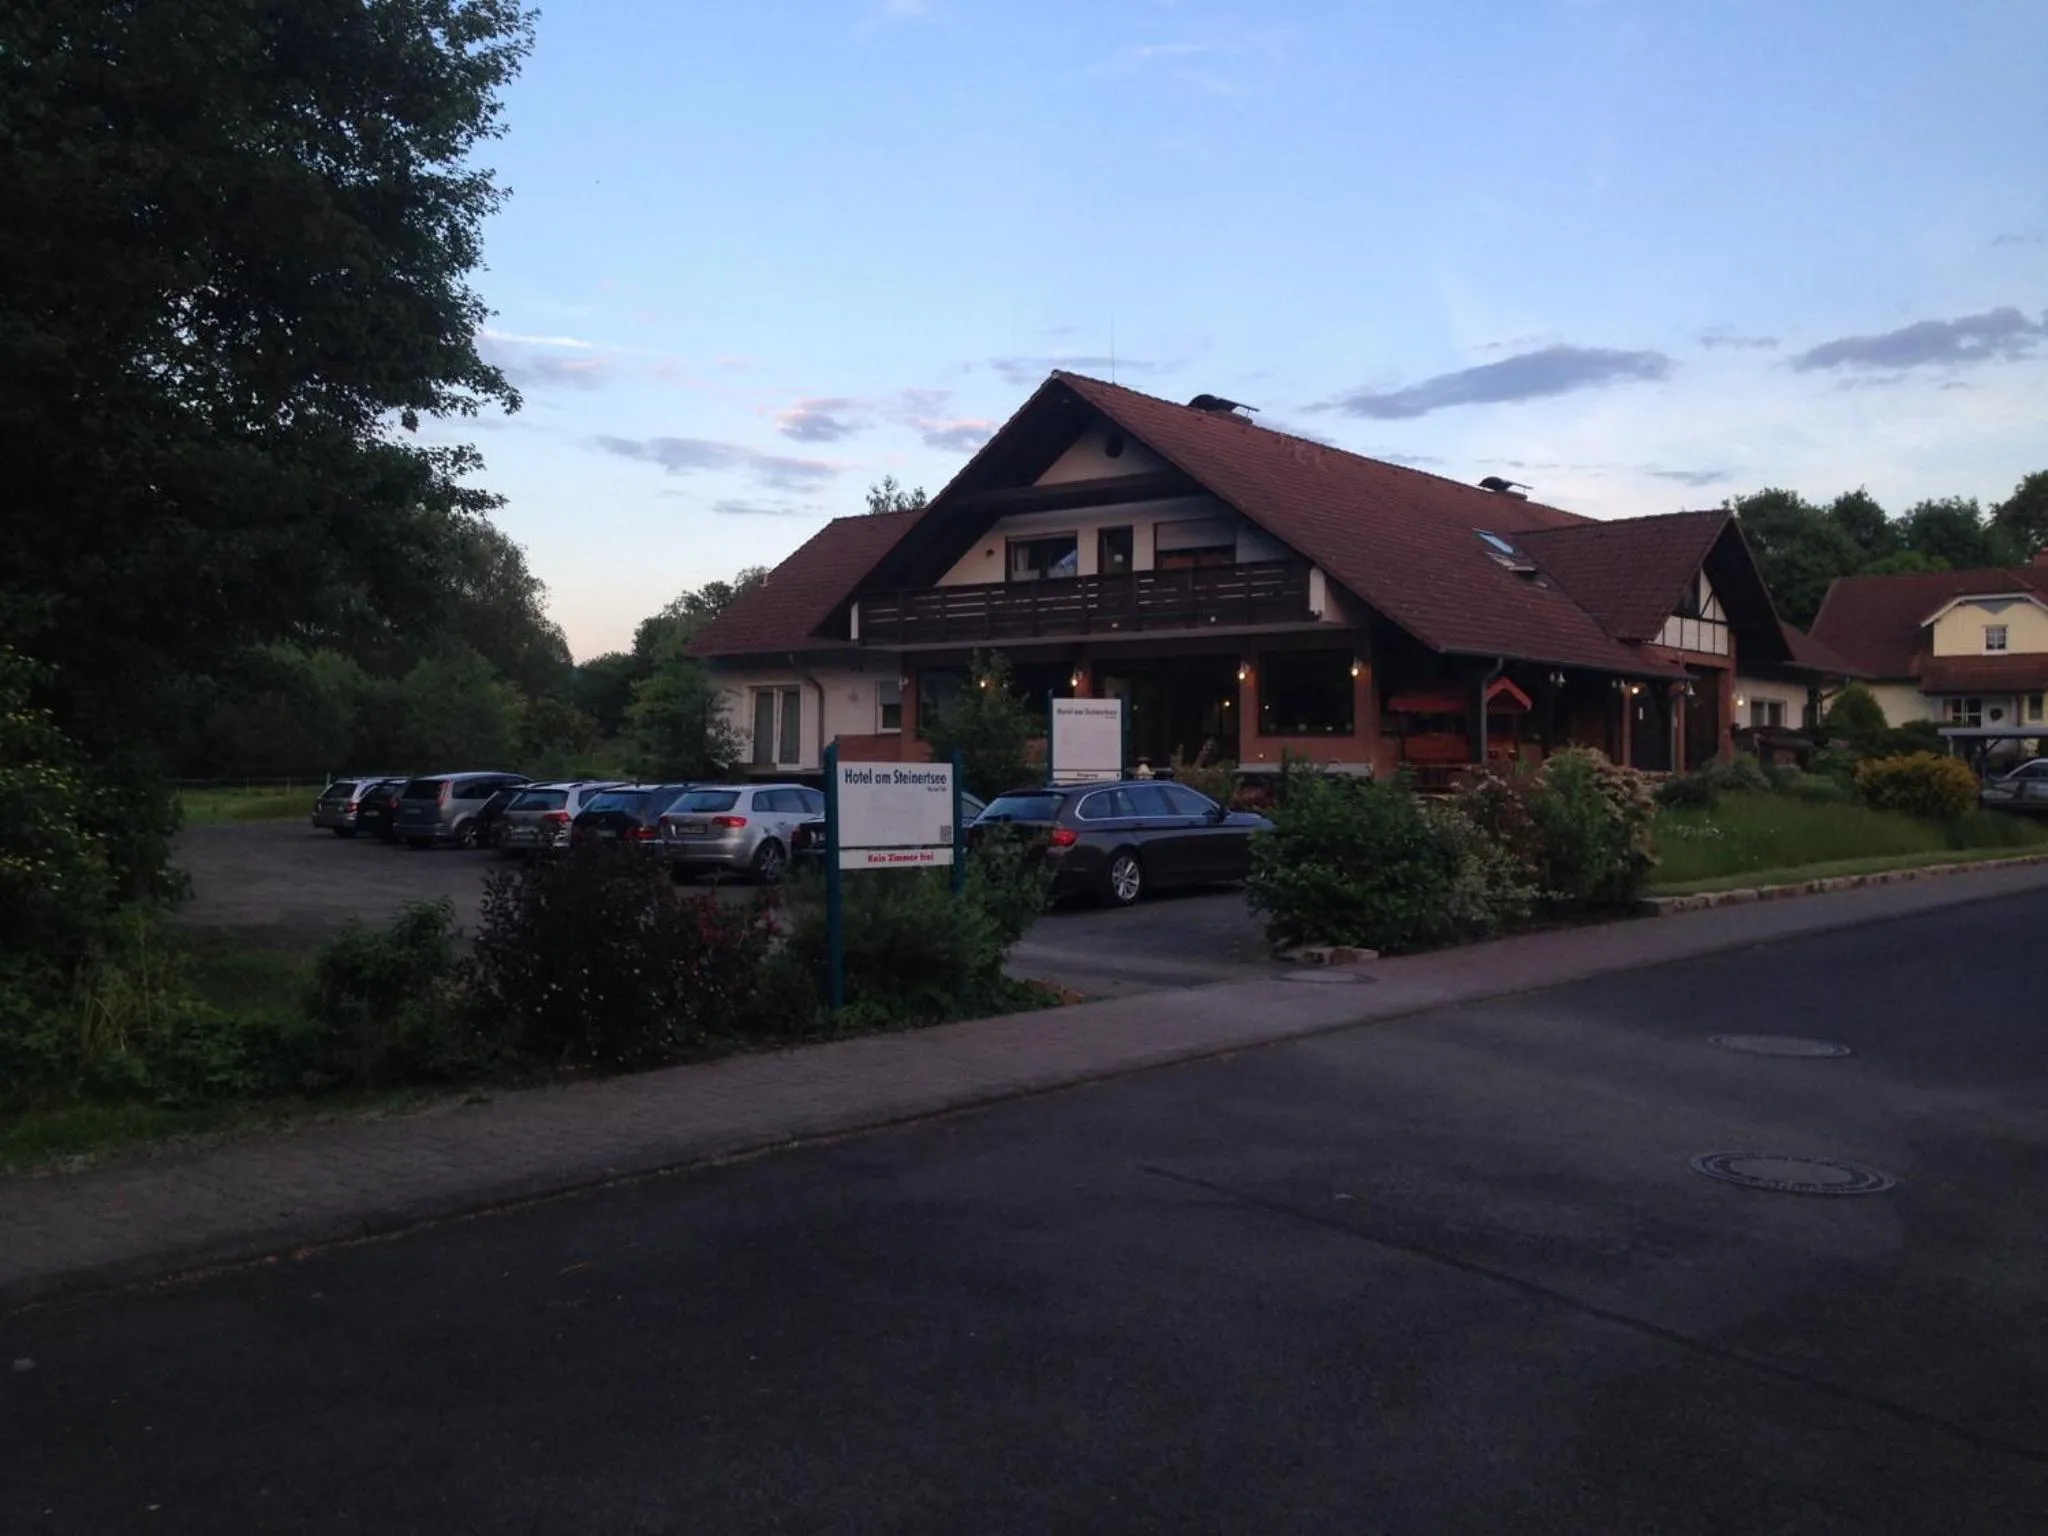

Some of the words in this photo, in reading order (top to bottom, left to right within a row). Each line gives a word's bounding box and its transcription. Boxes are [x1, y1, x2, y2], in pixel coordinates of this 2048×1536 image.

[845, 768, 872, 784] Hotel
[875, 773, 892, 784] am
[893, 769, 947, 784] Steinertsee
[868, 854, 887, 862] Kein
[888, 853, 918, 862] Zimmer
[919, 852, 934, 860] frei
